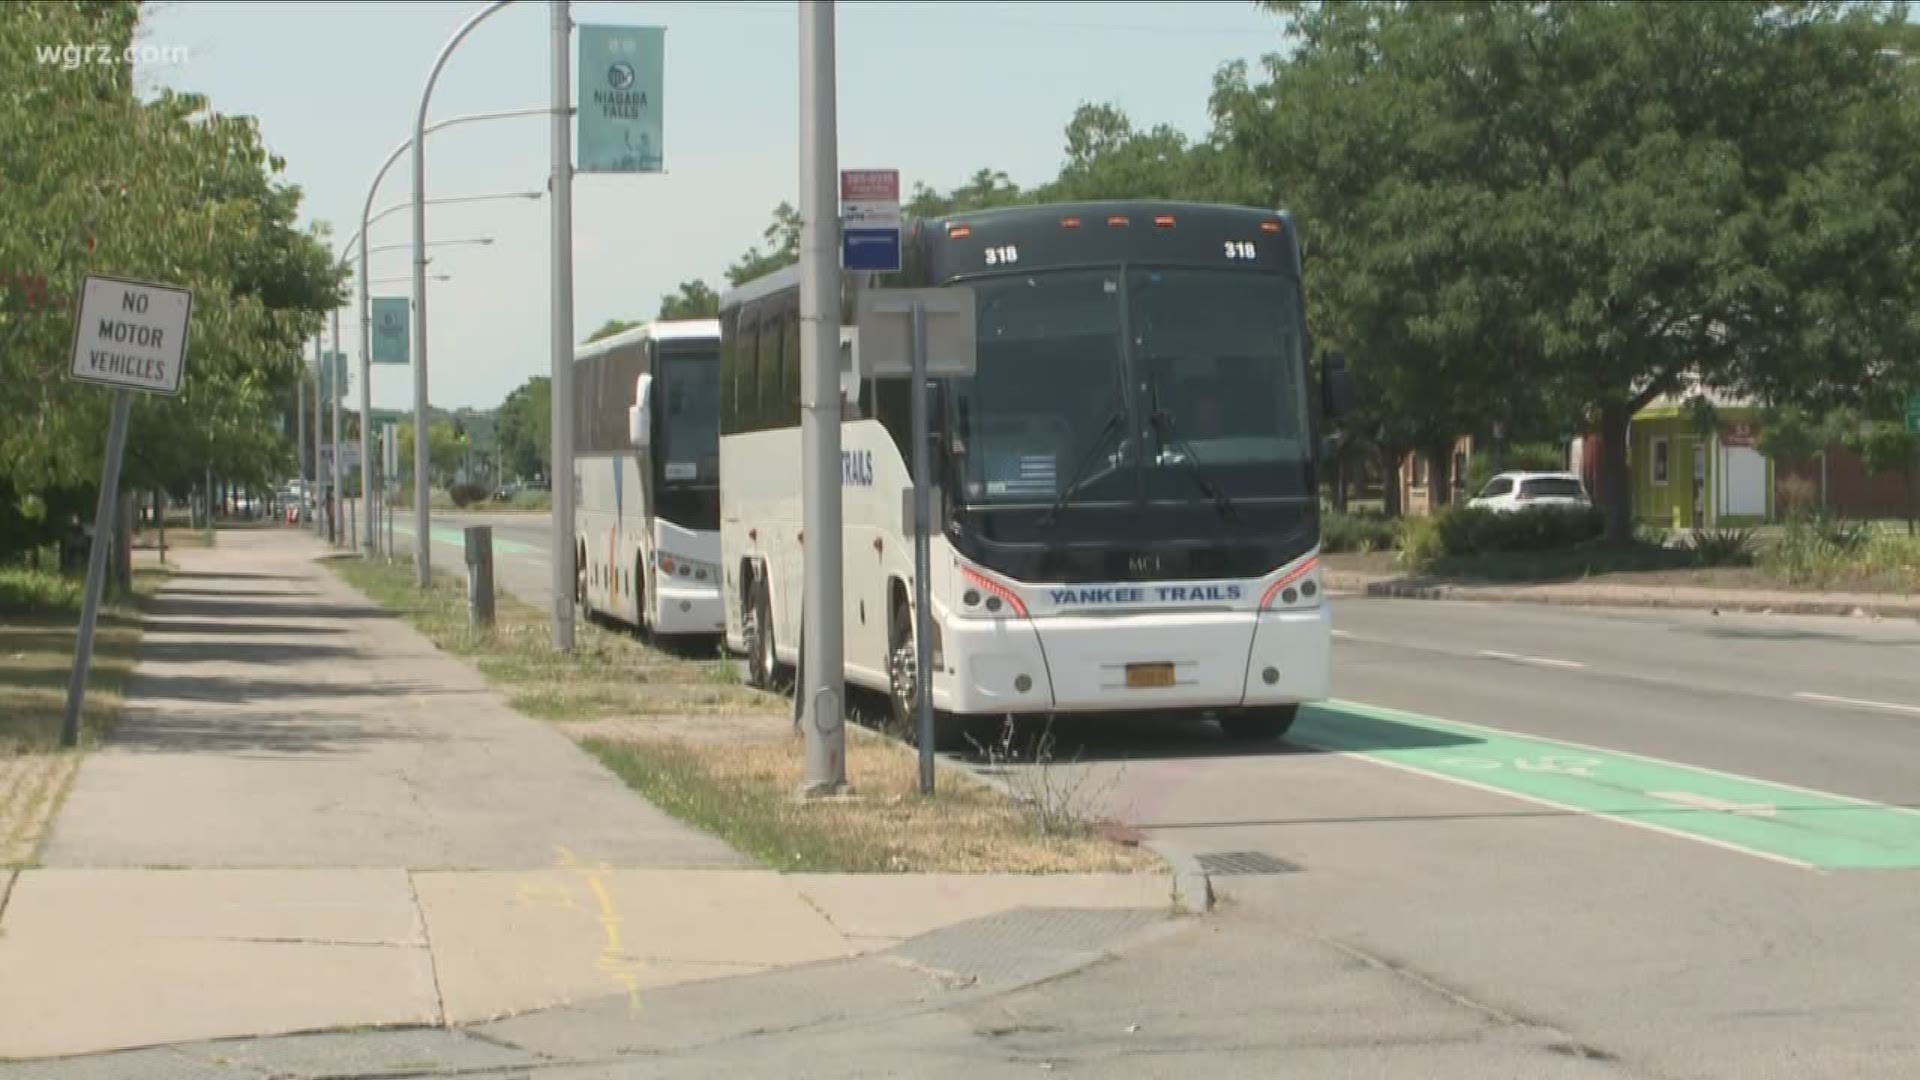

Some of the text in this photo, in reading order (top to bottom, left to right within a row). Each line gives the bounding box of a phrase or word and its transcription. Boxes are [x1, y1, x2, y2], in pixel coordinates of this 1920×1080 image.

[602, 105, 639, 119] FALLS
[985, 246, 1017, 264] 318
[1224, 240, 1255, 259] 318
[121, 290, 149, 314] NO
[98, 318, 164, 349] MOTOR
[89, 349, 165, 380] VEHICLES
[1050, 584, 1241, 605] YANKEE TRAILS
